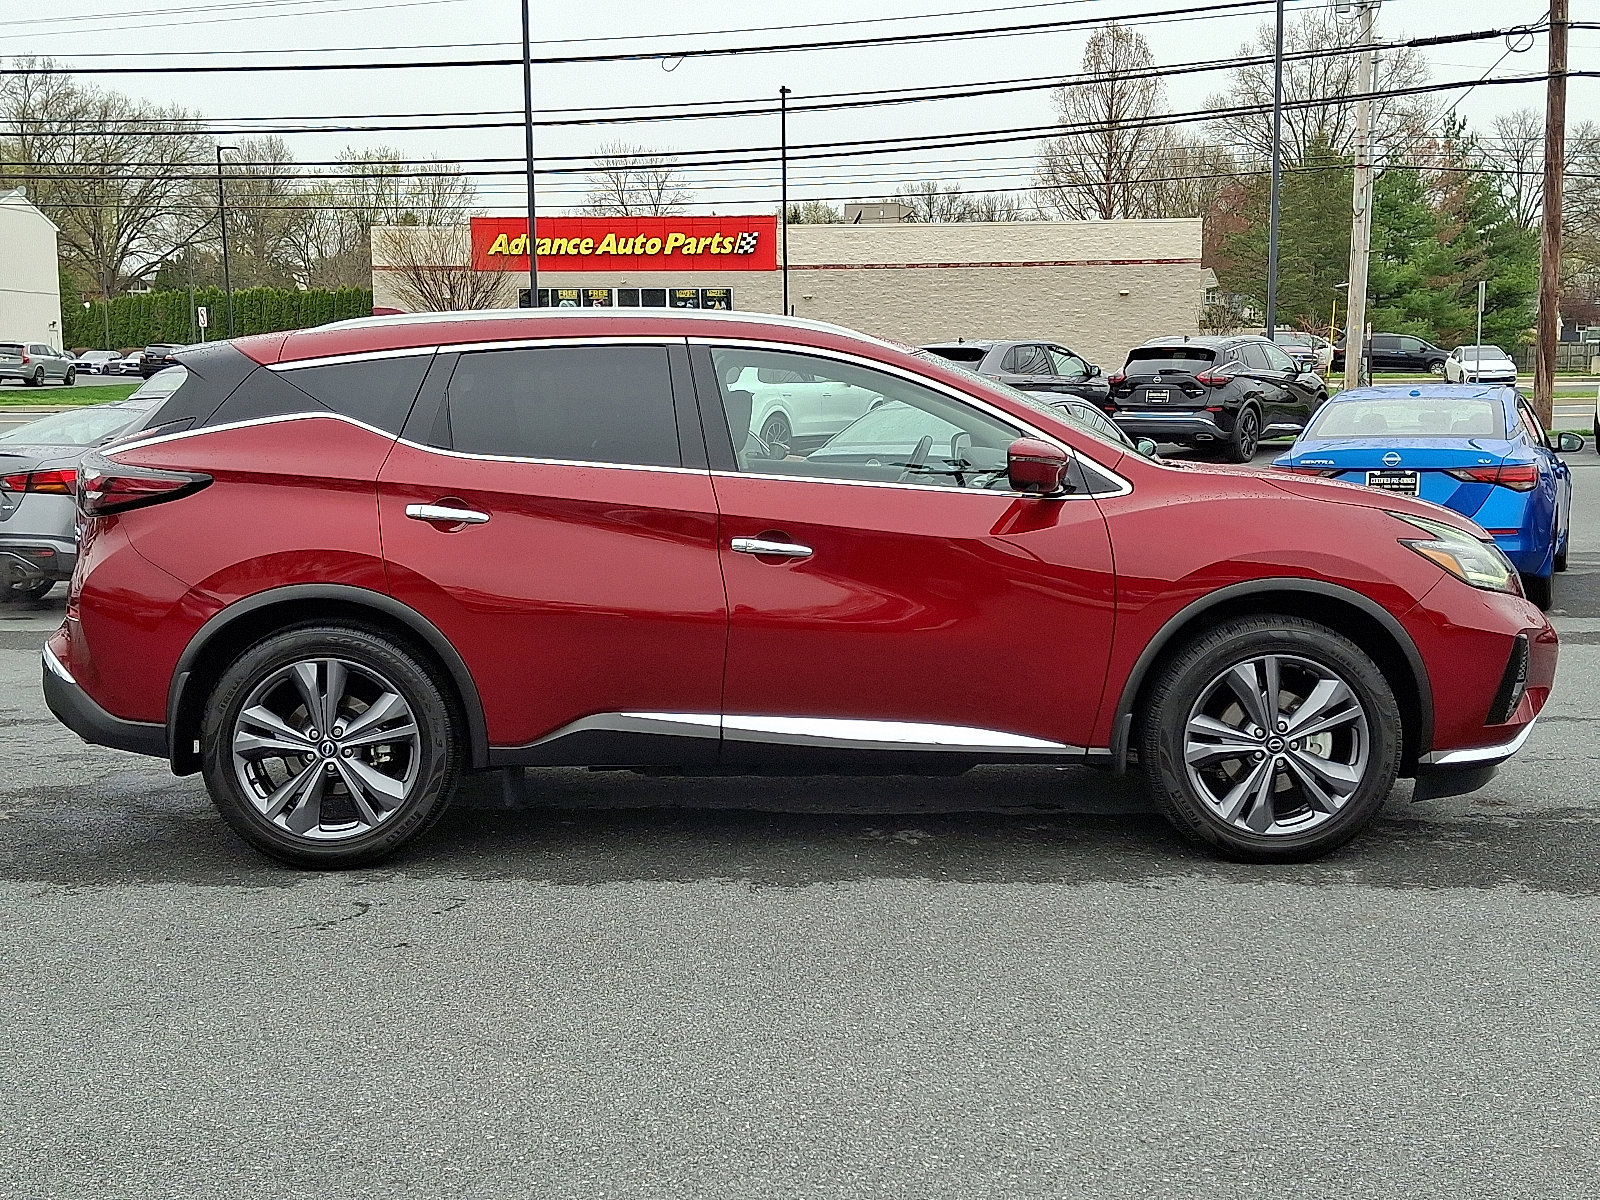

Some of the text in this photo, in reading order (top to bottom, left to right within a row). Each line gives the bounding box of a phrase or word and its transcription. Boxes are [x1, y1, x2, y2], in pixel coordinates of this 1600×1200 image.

[488, 232, 736, 255] Advance Auto Parts
